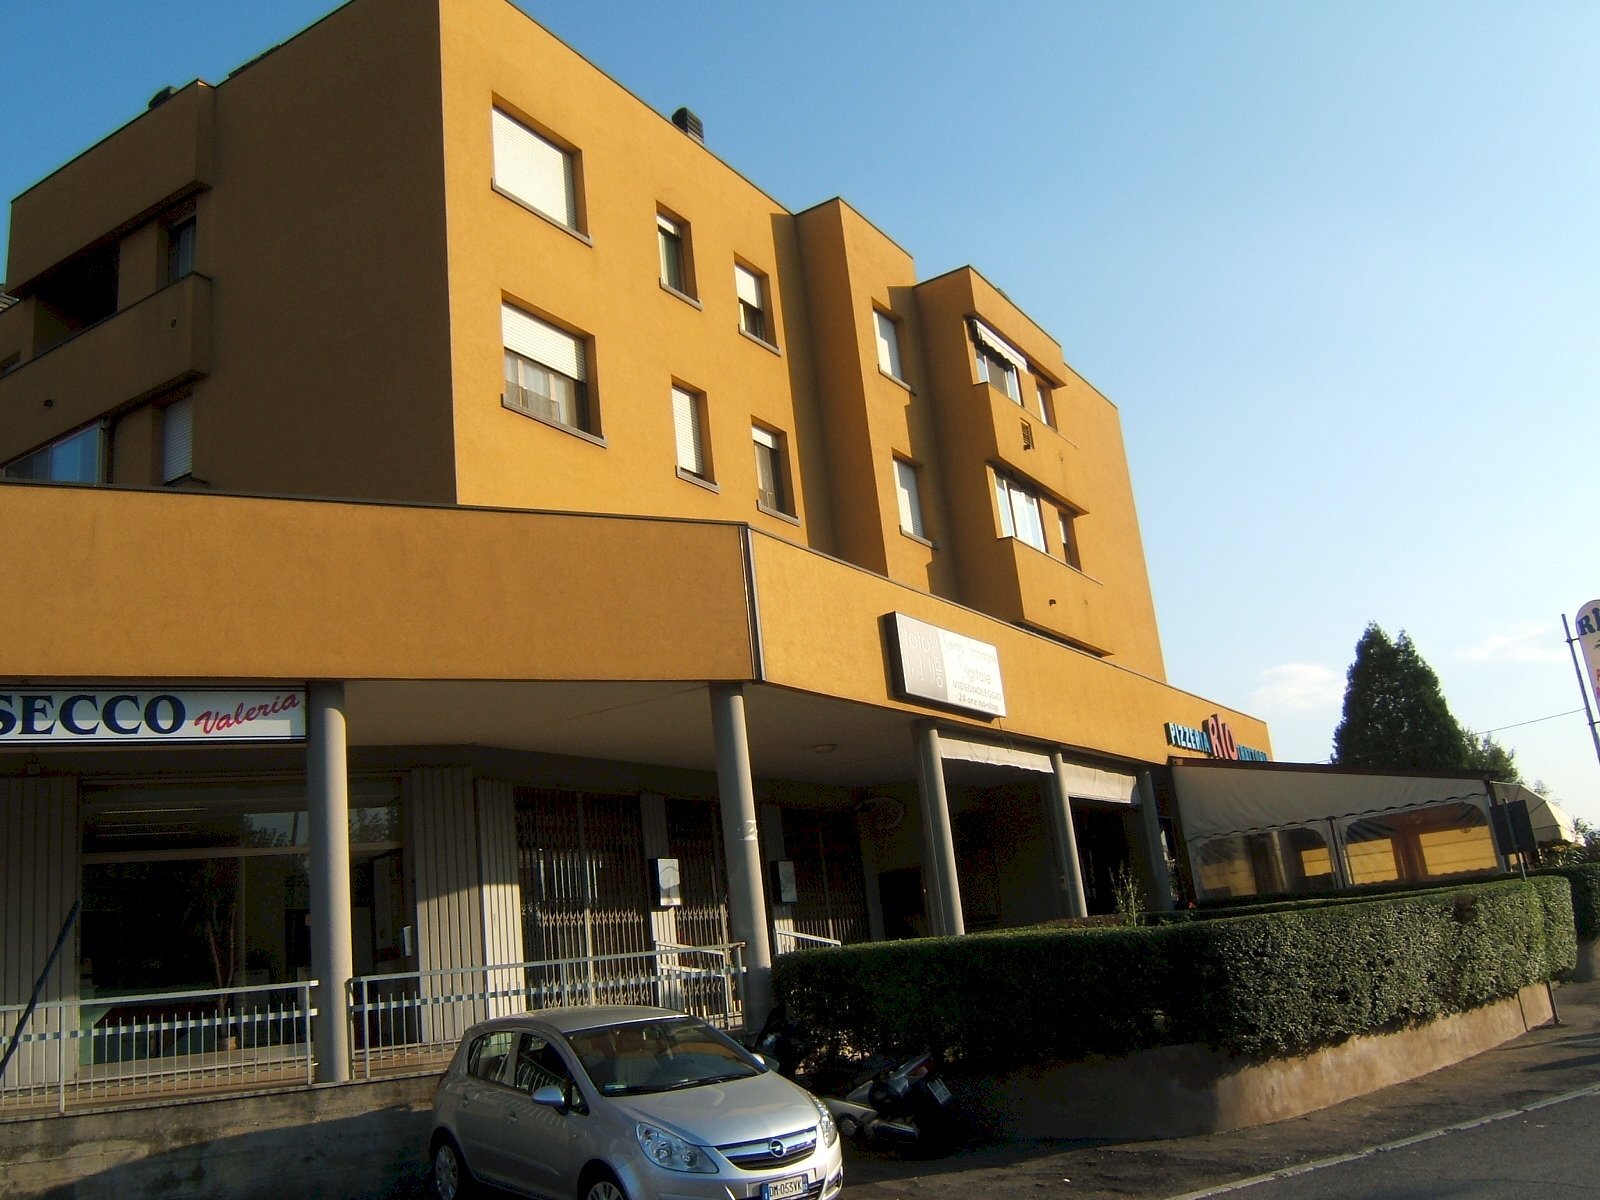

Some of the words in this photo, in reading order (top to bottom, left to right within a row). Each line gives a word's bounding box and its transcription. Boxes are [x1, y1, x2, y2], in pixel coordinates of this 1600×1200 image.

[194, 693, 300, 734] Valeria
[1166, 721, 1211, 753] PIZZERIA
[1206, 713, 1238, 760] RIO
